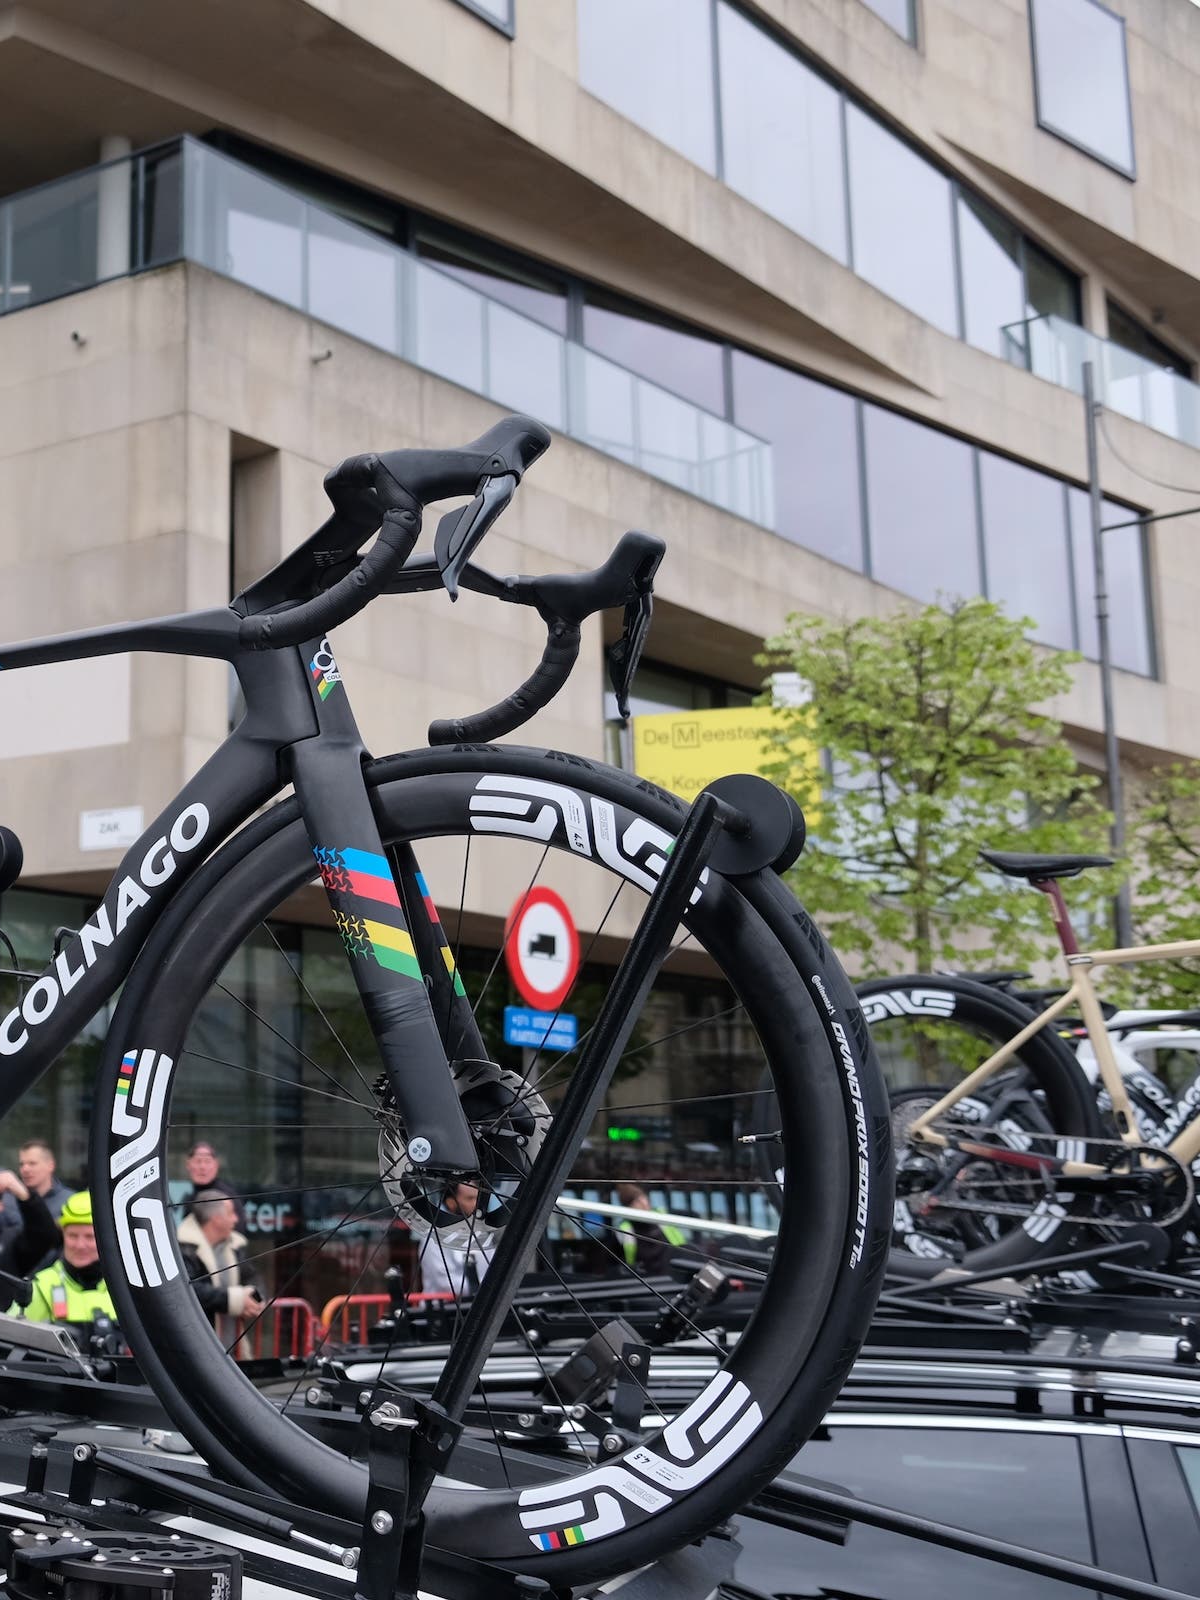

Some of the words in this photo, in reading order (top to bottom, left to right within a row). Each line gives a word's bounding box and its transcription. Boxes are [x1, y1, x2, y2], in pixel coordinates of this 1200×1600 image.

[830, 1021, 862, 1100] GRAND
[851, 1098, 869, 1158] PRIX
[143, 1165, 155, 1179] 4.5
[856, 1155, 869, 1228] 5000
[633, 1452, 651, 1464] 4.5
